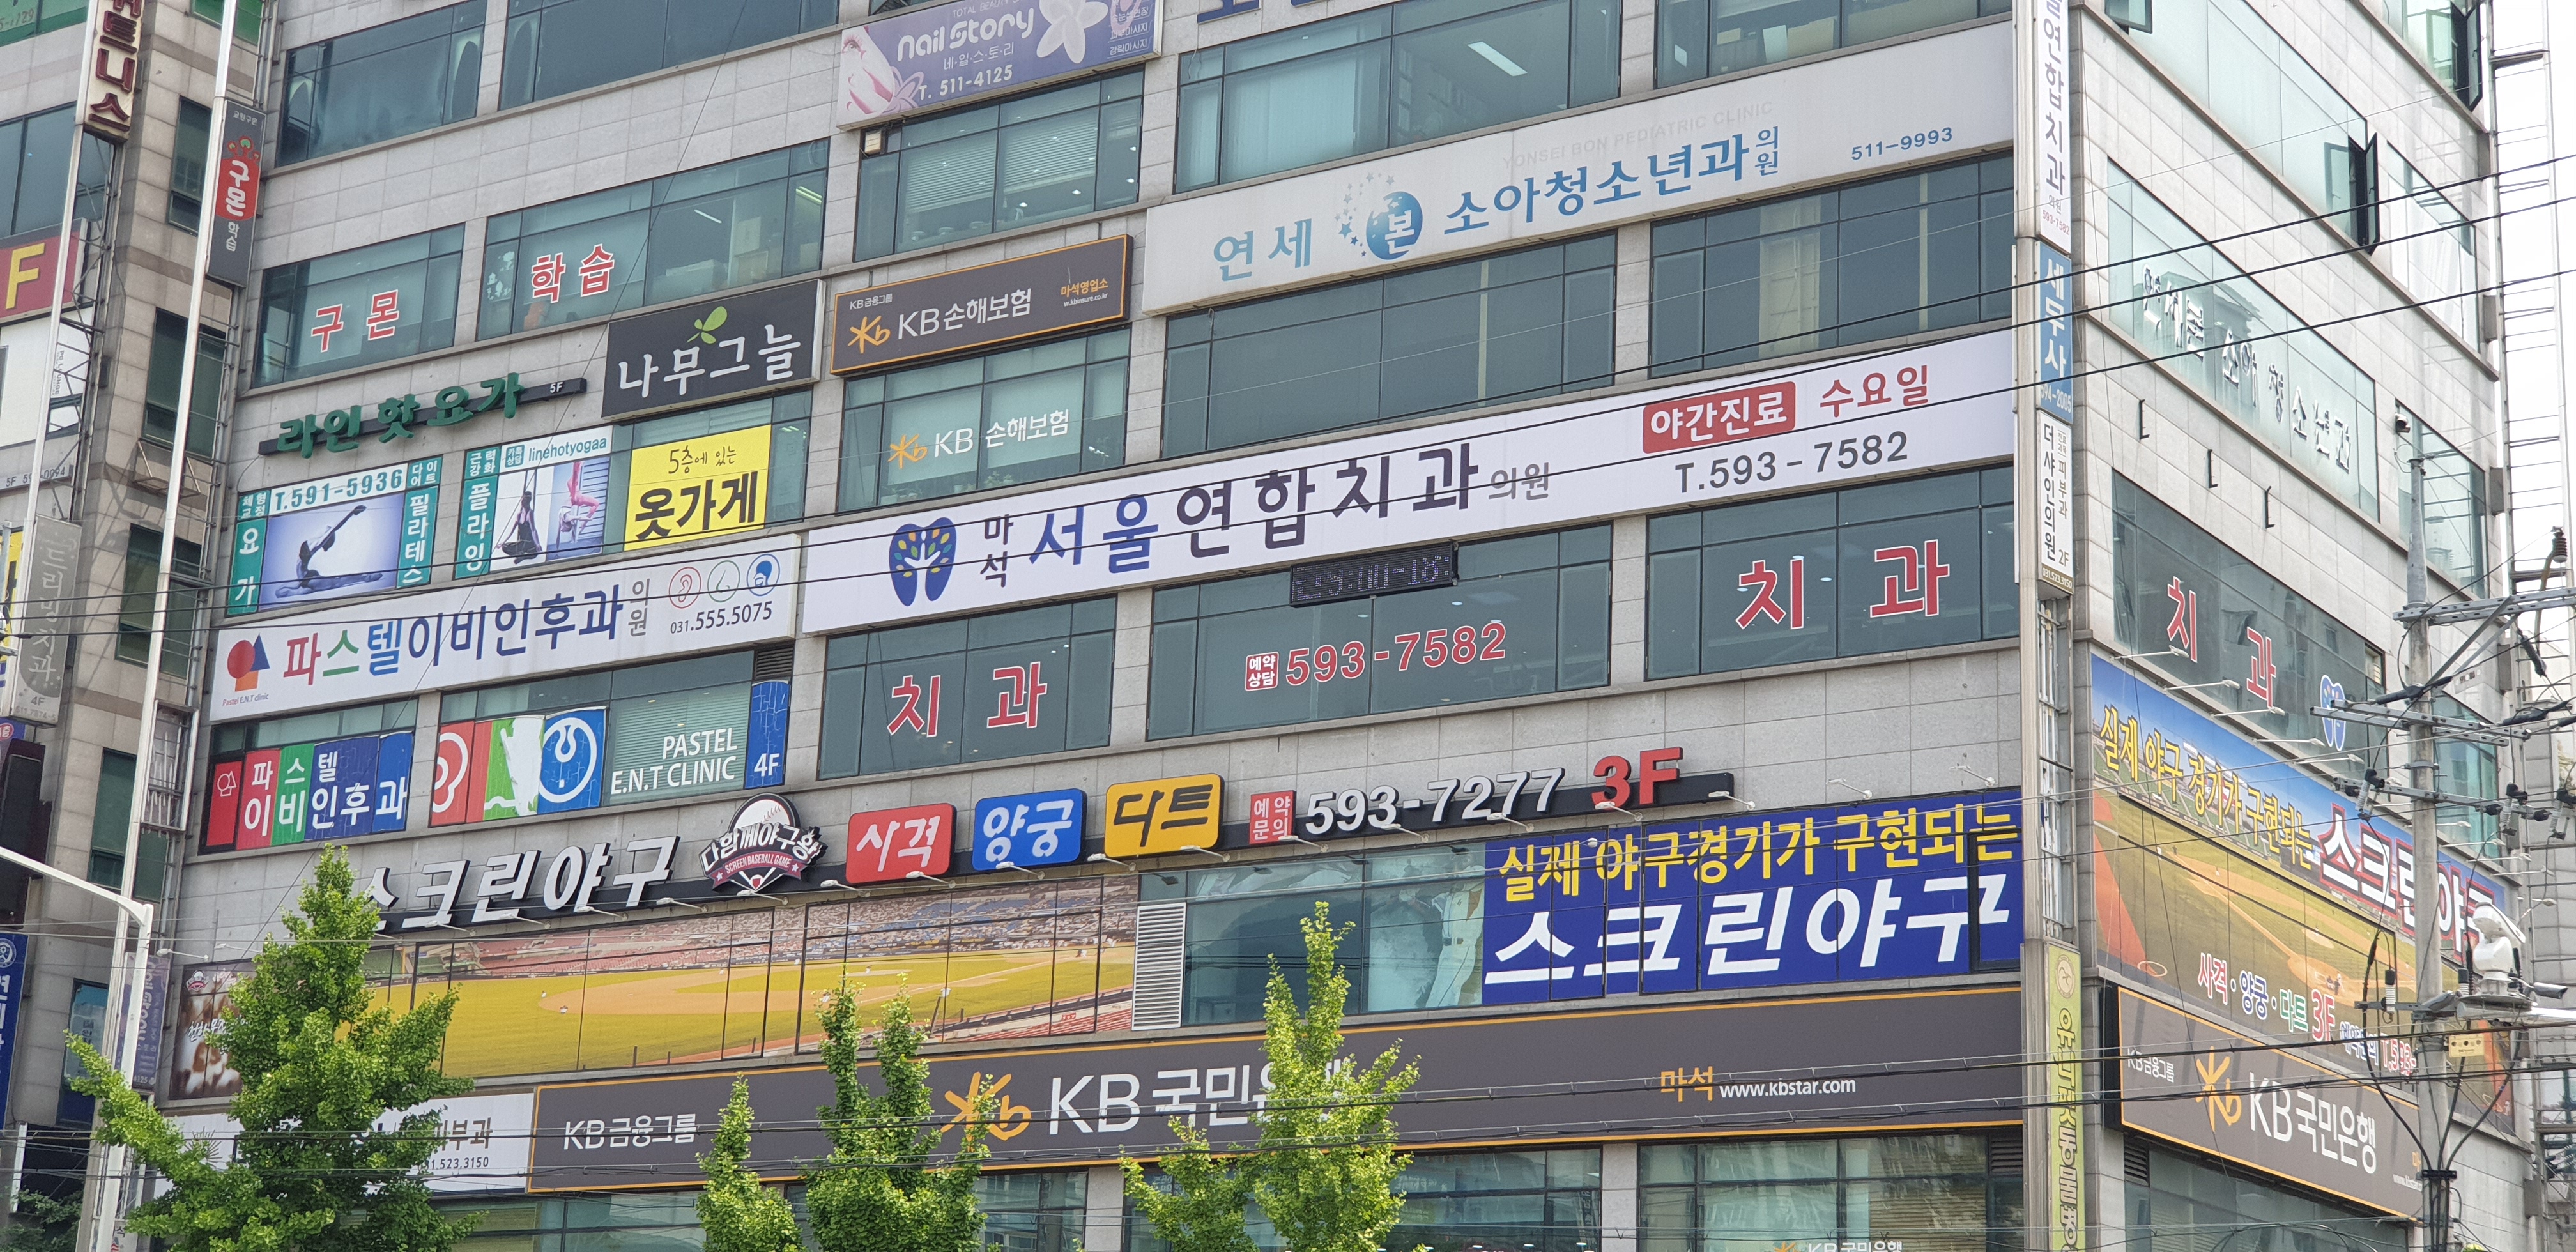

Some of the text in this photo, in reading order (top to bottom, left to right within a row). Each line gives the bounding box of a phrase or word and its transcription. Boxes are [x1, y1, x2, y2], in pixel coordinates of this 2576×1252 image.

[952, 6, 976, 18] TOTAL
[88, 0, 142, 132] 트니스
[1110, 39, 1147, 56] 경락마사지
[939, 64, 1013, 96] 511-4125
[2043, 0, 2066, 195] 연합치과
[1851, 126, 1953, 161] 511-9993
[226, 160, 250, 217] 구몬
[1213, 218, 1312, 282] 연세
[1383, 211, 1415, 255] 본
[1444, 134, 1749, 235] 소아청소년과
[226, 221, 239, 252] 학습
[531, 243, 615, 303] 학습
[1061, 278, 1108, 298] 마석영업소
[311, 289, 399, 352] 구몬
[850, 293, 893, 310] KB금융그룹
[2045, 258, 2067, 378] 세무사
[549, 382, 563, 393] 5F
[618, 324, 801, 398] 나무그늘
[1650, 365, 1929, 442] 야간진료 수요일
[277, 405, 362, 459] 라인
[529, 437, 607, 462] linehotyogaa
[668, 445, 736, 474] 5층에 있는
[6, 477, 17, 487] 5F
[275, 469, 403, 514] T.591-5936
[635, 471, 758, 540] 옷가게
[1488, 462, 1551, 500] 의원
[2043, 423, 2056, 562] 더샤인의원
[402, 494, 430, 583] 필라테스
[464, 484, 491, 572] 플라잉
[234, 526, 259, 605] 요가
[1735, 539, 1950, 630] 치과
[2058, 549, 2069, 567] 2F
[282, 584, 624, 685] 파스텔이비인후과
[670, 601, 773, 634] 031.555.5075
[2166, 577, 2276, 708] 치과
[1248, 655, 1276, 670] 예약
[1248, 670, 1275, 687] 상담
[1285, 622, 1506, 686] 593-7582
[31, 696, 45, 706] 4F
[222, 698, 239, 706] Pastel
[887, 661, 1047, 738] 치과
[252, 751, 338, 791] 파스텔
[663, 728, 738, 760] PASTEL
[666, 756, 737, 788] CLINIC
[754, 753, 779, 777] 4F
[244, 777, 408, 836] 이비인후과
[1113, 784, 1213, 847] 다트
[1305, 746, 1683, 836] 593-7277 3F
[2100, 705, 2138, 783] 실제
[2145, 728, 2183, 802] 야구
[2187, 755, 2242, 834] 경기가
[2246, 786, 2313, 871] 구현되는
[856, 816, 940, 872] 사격
[982, 800, 1074, 862] 양궁
[1500, 839, 1579, 902] 실제
[1833, 802, 2020, 873] 구현되는
[364, 836, 680, 929] 스크린야구
[725, 853, 790, 874] SCREEN BASEBALL GAME
[1485, 874, 2007, 985] 스크린야구
[2198, 952, 2228, 1004] 사격
[2239, 970, 2268, 1020] 양궁
[2280, 988, 2308, 1032] 다트
[2312, 988, 2336, 1042] 3F
[1660, 1065, 1856, 1102] 마석 www.kbstar.com
[2127, 1048, 2175, 1083] KB금융그룹
[564, 1113, 696, 1150] KB금융그룹
[2249, 1072, 2376, 1174] KB국민은행
[426, 1157, 489, 1171] 31.523.3150
